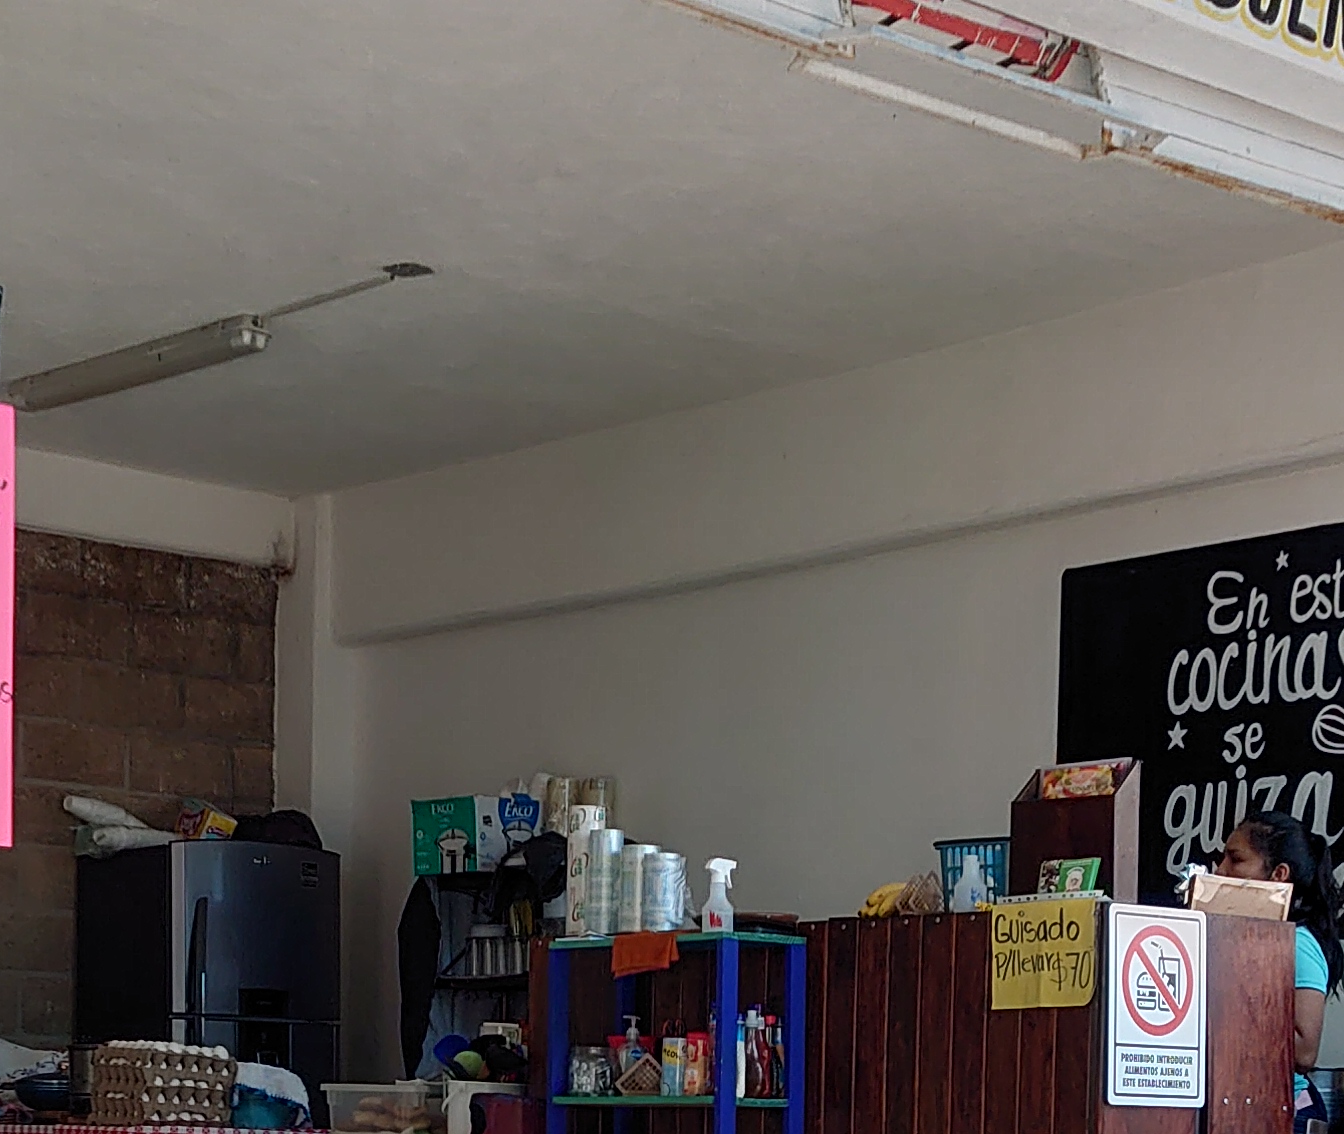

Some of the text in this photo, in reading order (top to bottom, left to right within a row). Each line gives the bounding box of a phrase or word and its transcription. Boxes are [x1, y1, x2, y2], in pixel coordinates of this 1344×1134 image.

[1206, 570, 1270, 634] En
[1167, 628, 1342, 716] cocina
[1221, 722, 1266, 764] se
[994, 907, 1080, 944] Guisado
[1120, 1052, 1193, 1066] PROHIBIDO INTRODUCIR
[1124, 1065, 1189, 1077] ALIMENTOS AJENOS A
[1122, 1077, 1191, 1090] ESTE ESTABLECIMIENTO
